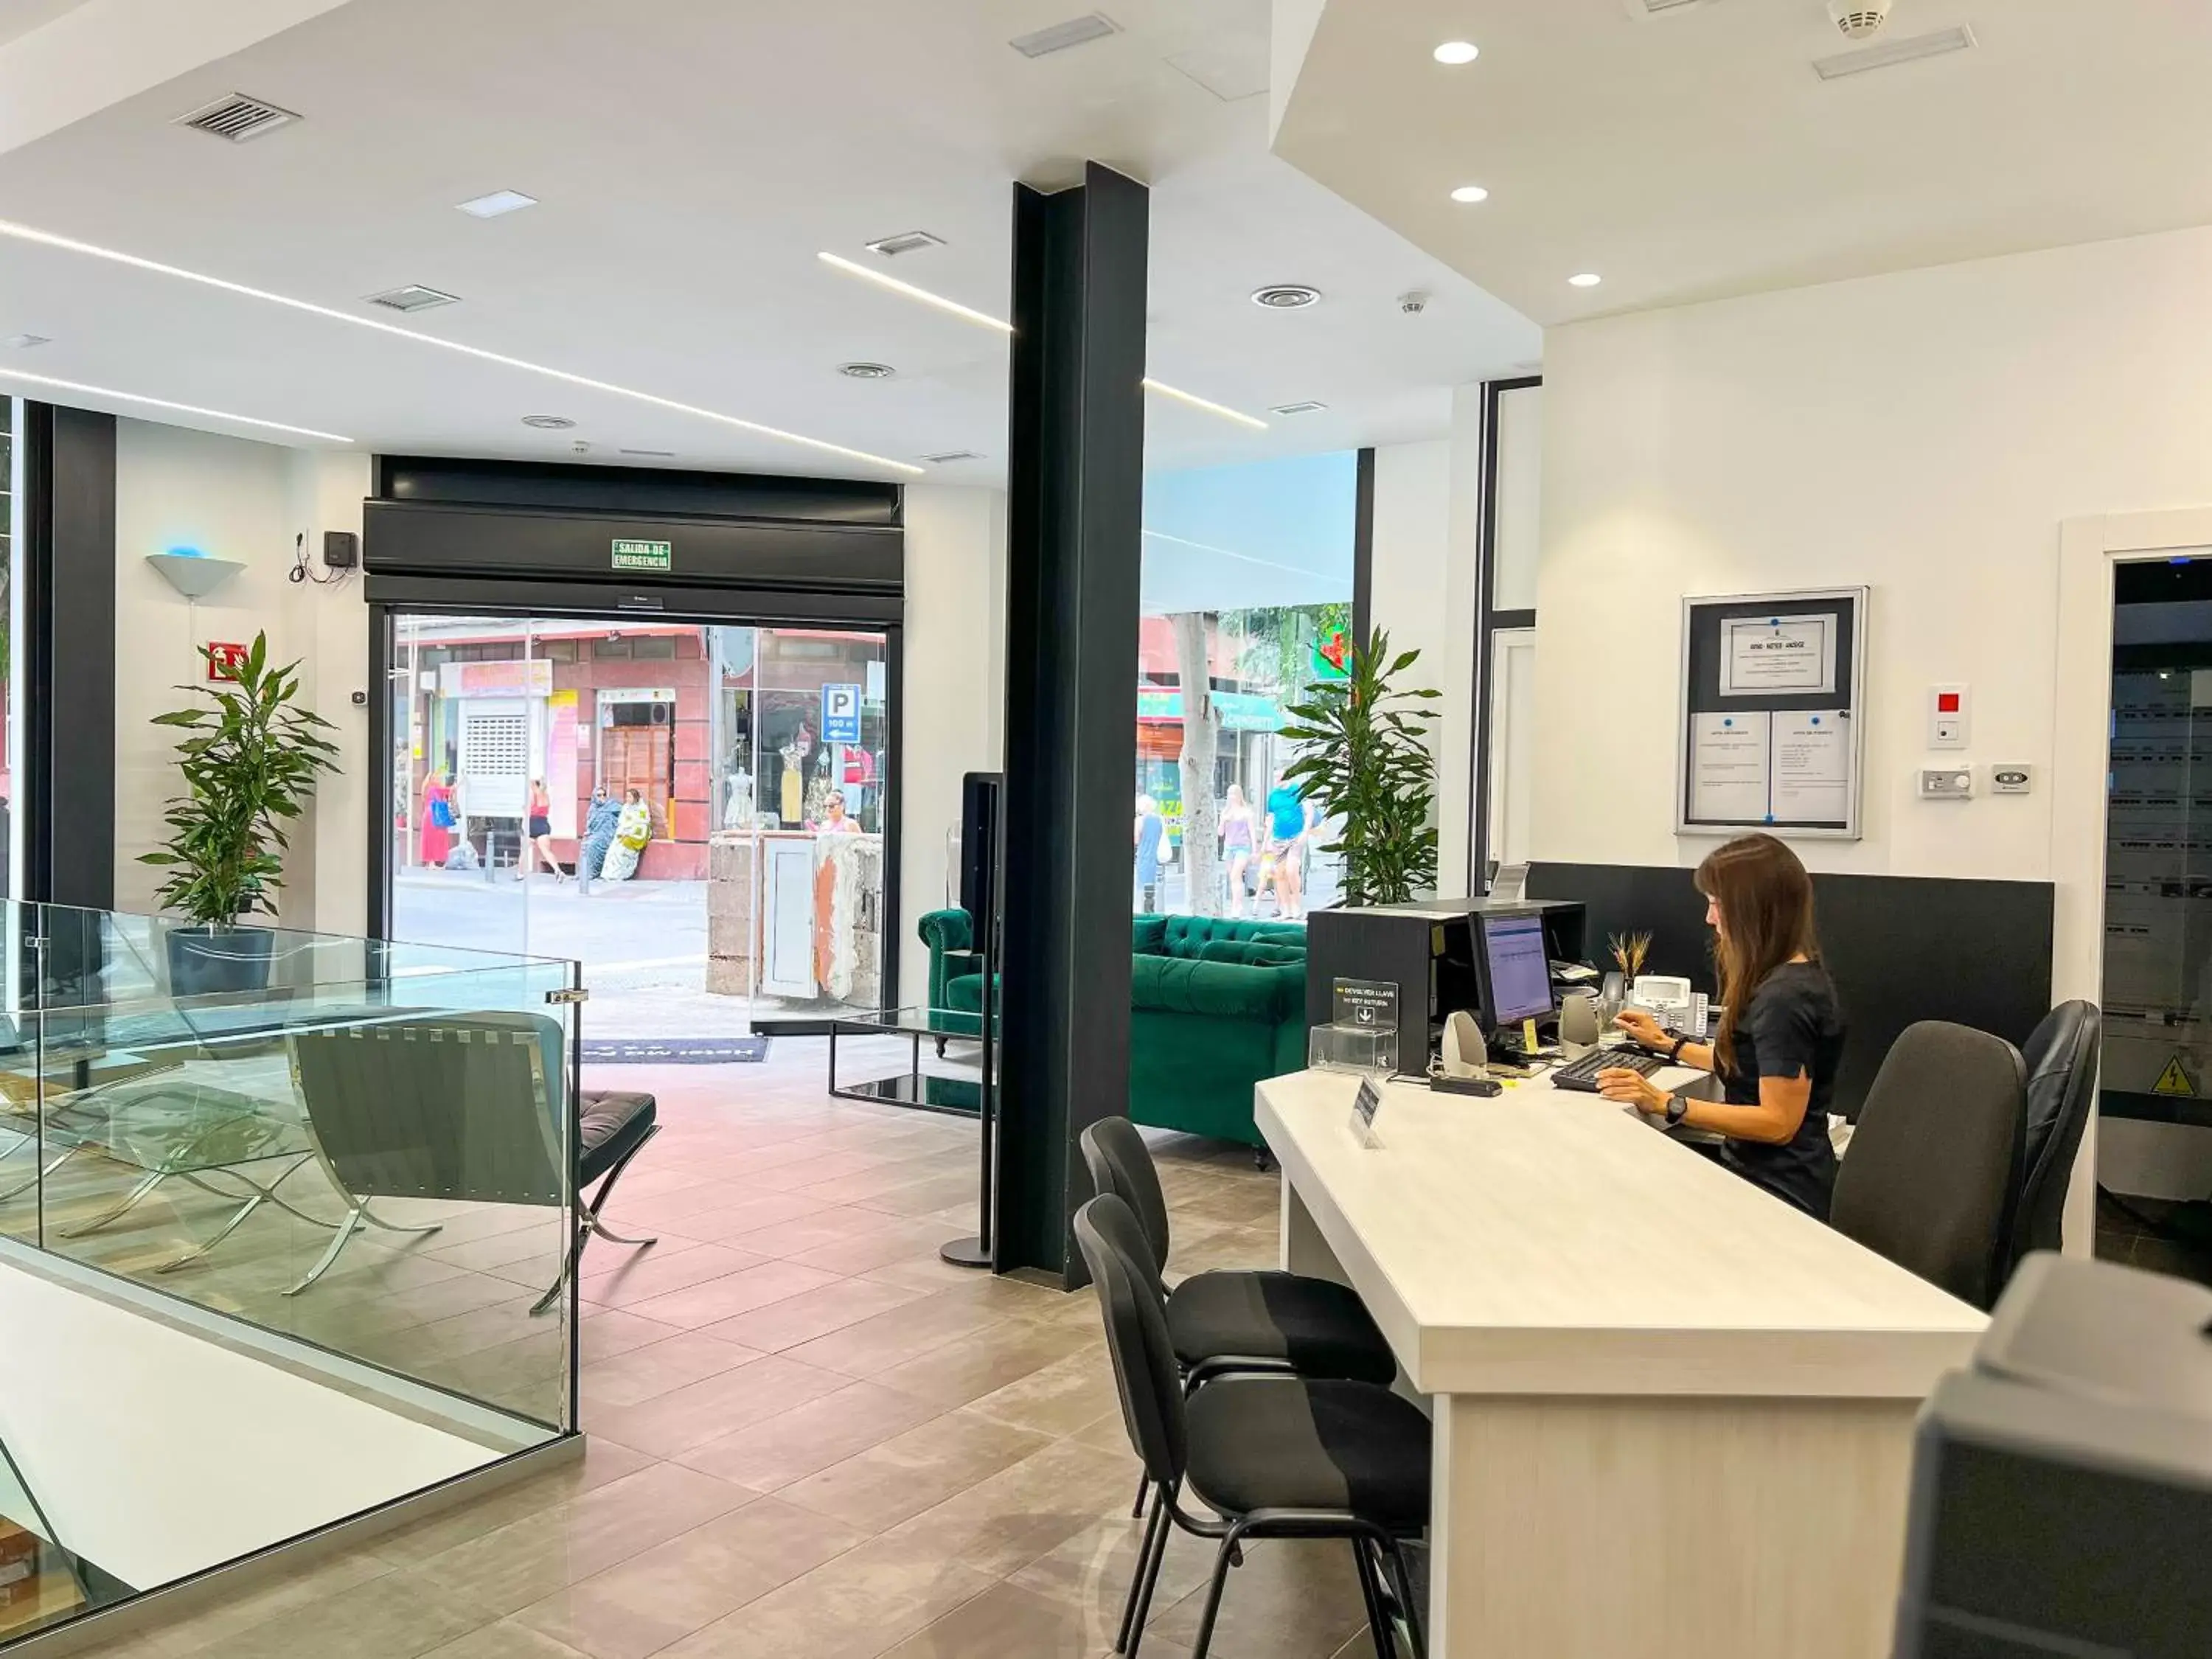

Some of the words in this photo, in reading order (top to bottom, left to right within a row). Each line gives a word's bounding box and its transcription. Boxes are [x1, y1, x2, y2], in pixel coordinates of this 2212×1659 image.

[619, 543, 650, 554] SALIDA
[653, 545, 664, 555] DE
[614, 554, 667, 567] EMERGENCIA
[833, 693, 849, 714] P
[828, 719, 844, 728] 100
